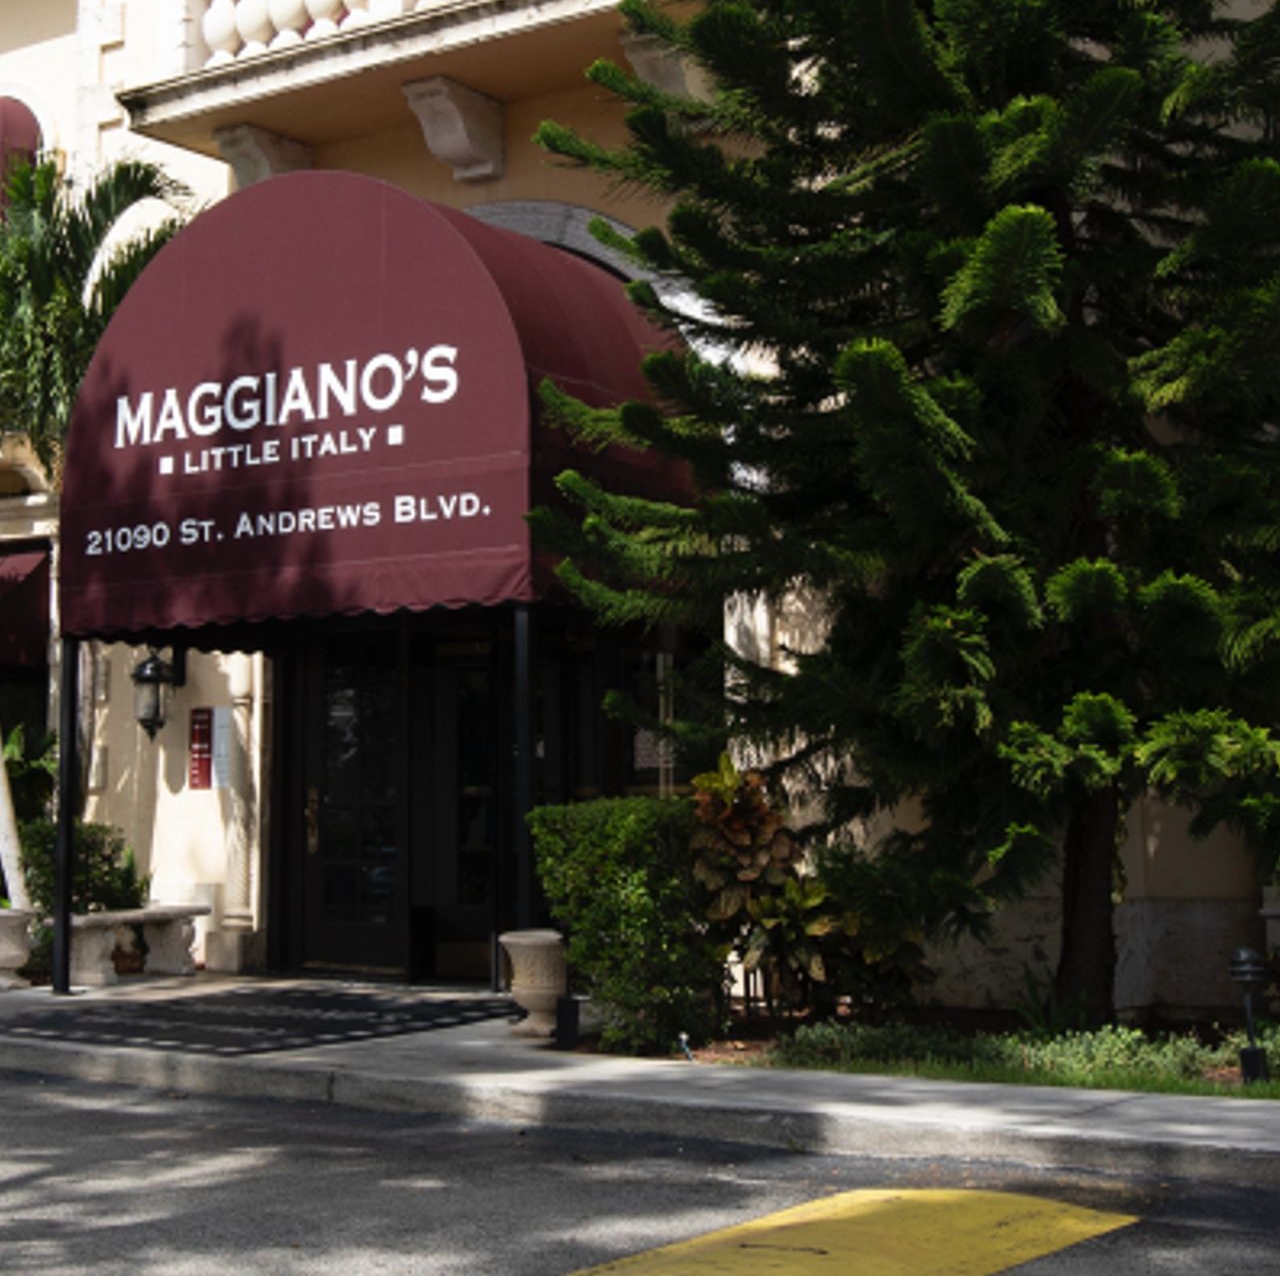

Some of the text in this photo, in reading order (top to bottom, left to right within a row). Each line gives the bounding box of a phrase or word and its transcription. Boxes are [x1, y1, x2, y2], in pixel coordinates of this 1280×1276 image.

[114, 345, 458, 448] MAGGIANO'S
[183, 427, 377, 474] LITTLE ITALY
[85, 492, 492, 555] 21090 ST. ANDREWS BLVD.
